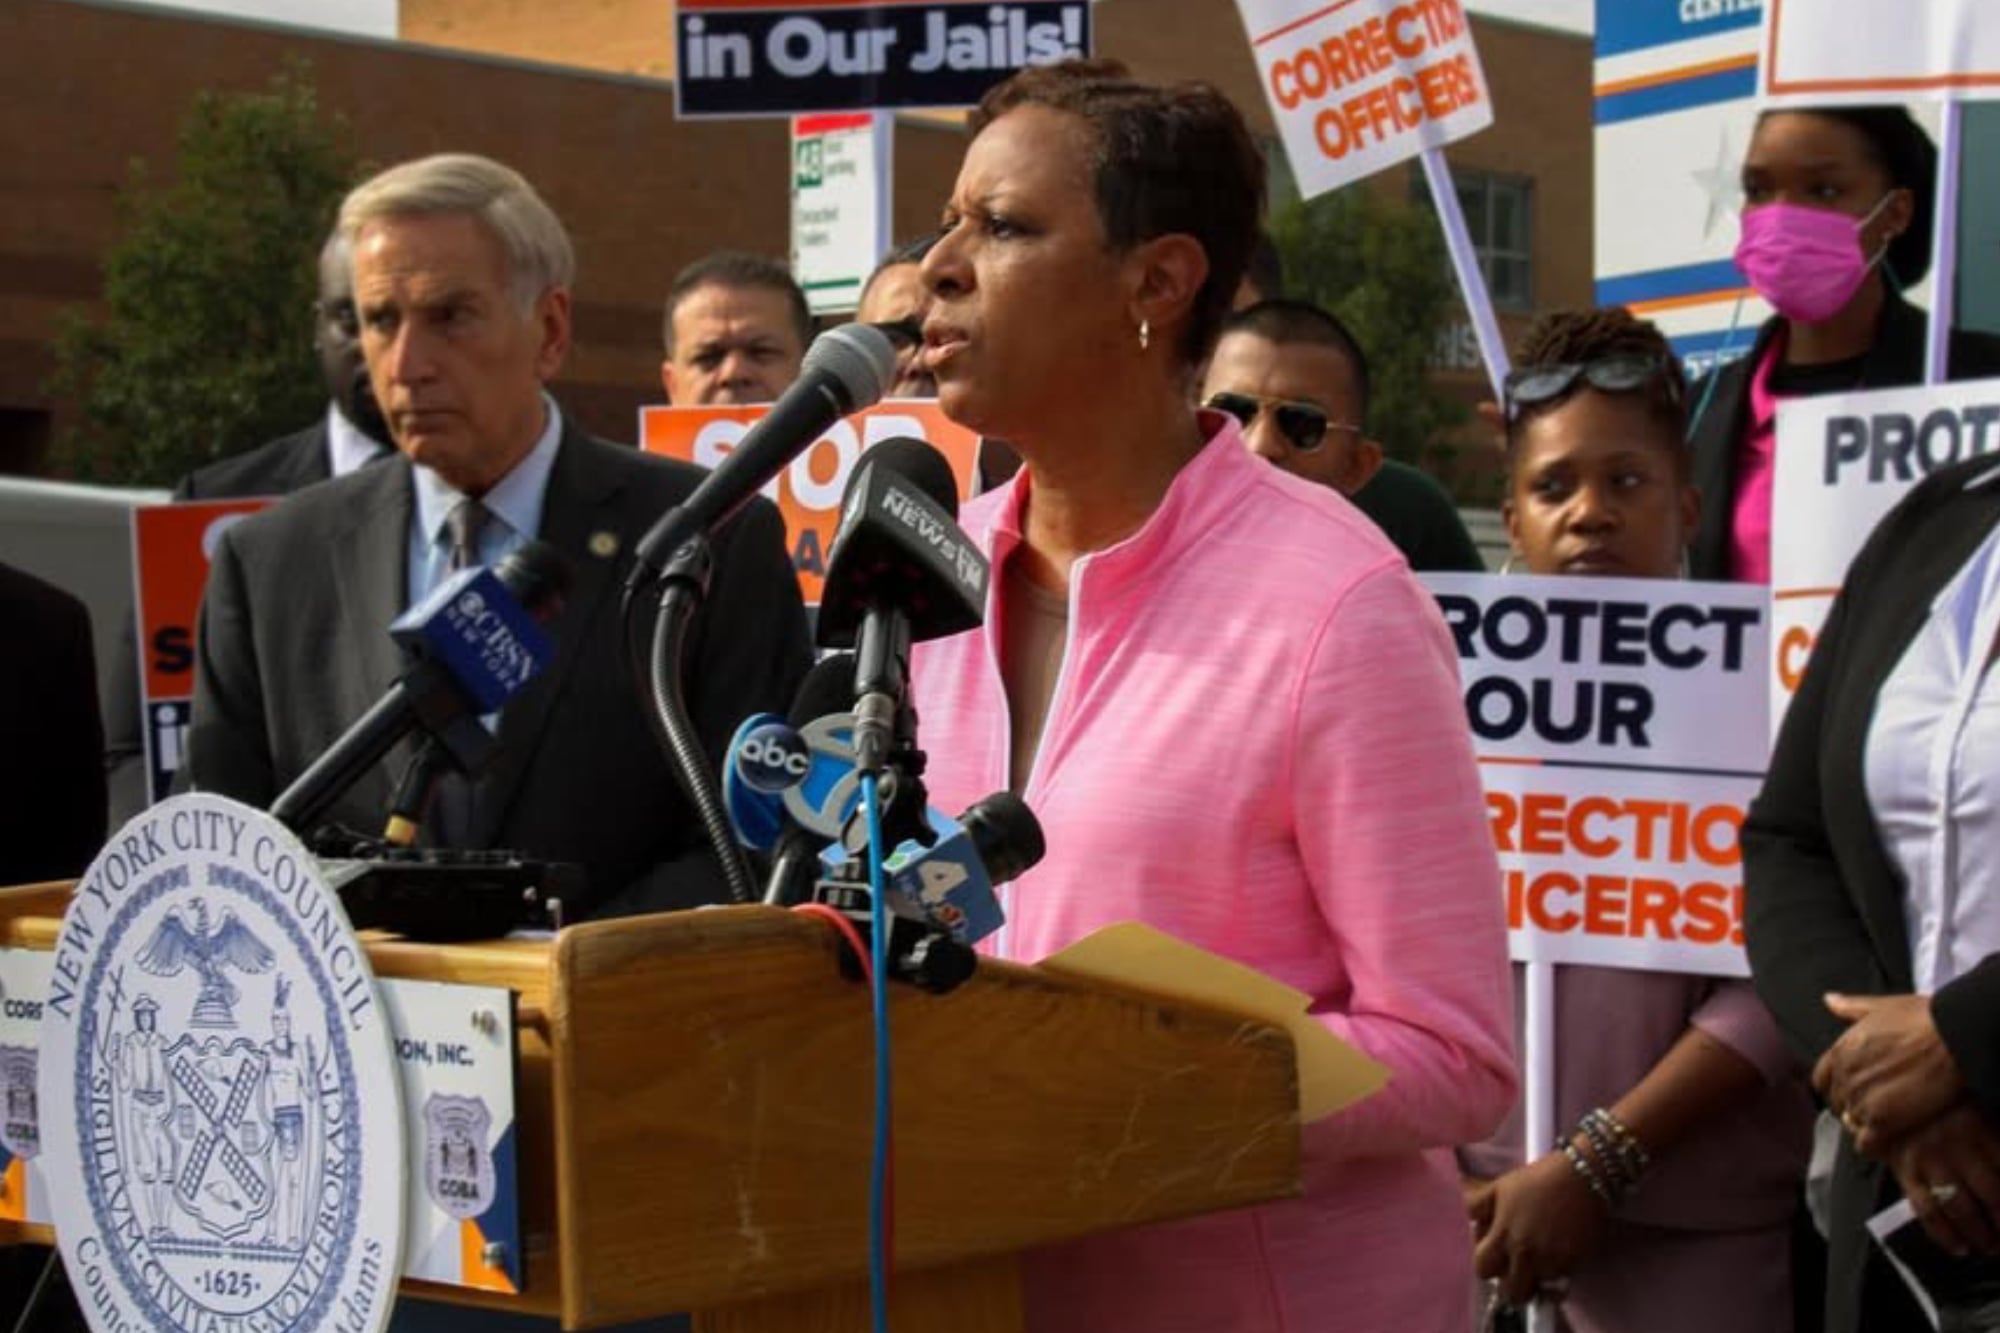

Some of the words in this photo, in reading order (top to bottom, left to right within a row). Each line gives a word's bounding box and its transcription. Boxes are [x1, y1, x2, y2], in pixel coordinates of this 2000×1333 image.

[685, 18, 752, 79] in
[766, 16, 898, 77] Our
[909, 6, 1083, 72] Jails!
[1314, 54, 1478, 160] OFFICERS
[692, 415, 928, 512] SO
[1434, 594, 1761, 672] ROTECT
[1465, 675, 1655, 747] OUR
[741, 737, 809, 775] abc
[1484, 791, 1747, 868] RECTIO
[50, 907, 96, 1019] NEW
[86, 818, 168, 910] YORK
[171, 809, 247, 858] CITY
[253, 835, 372, 1032] COUNCIL
[1507, 869, 1746, 948] ICERS!
[203, 1269, 253, 1298] 1625
